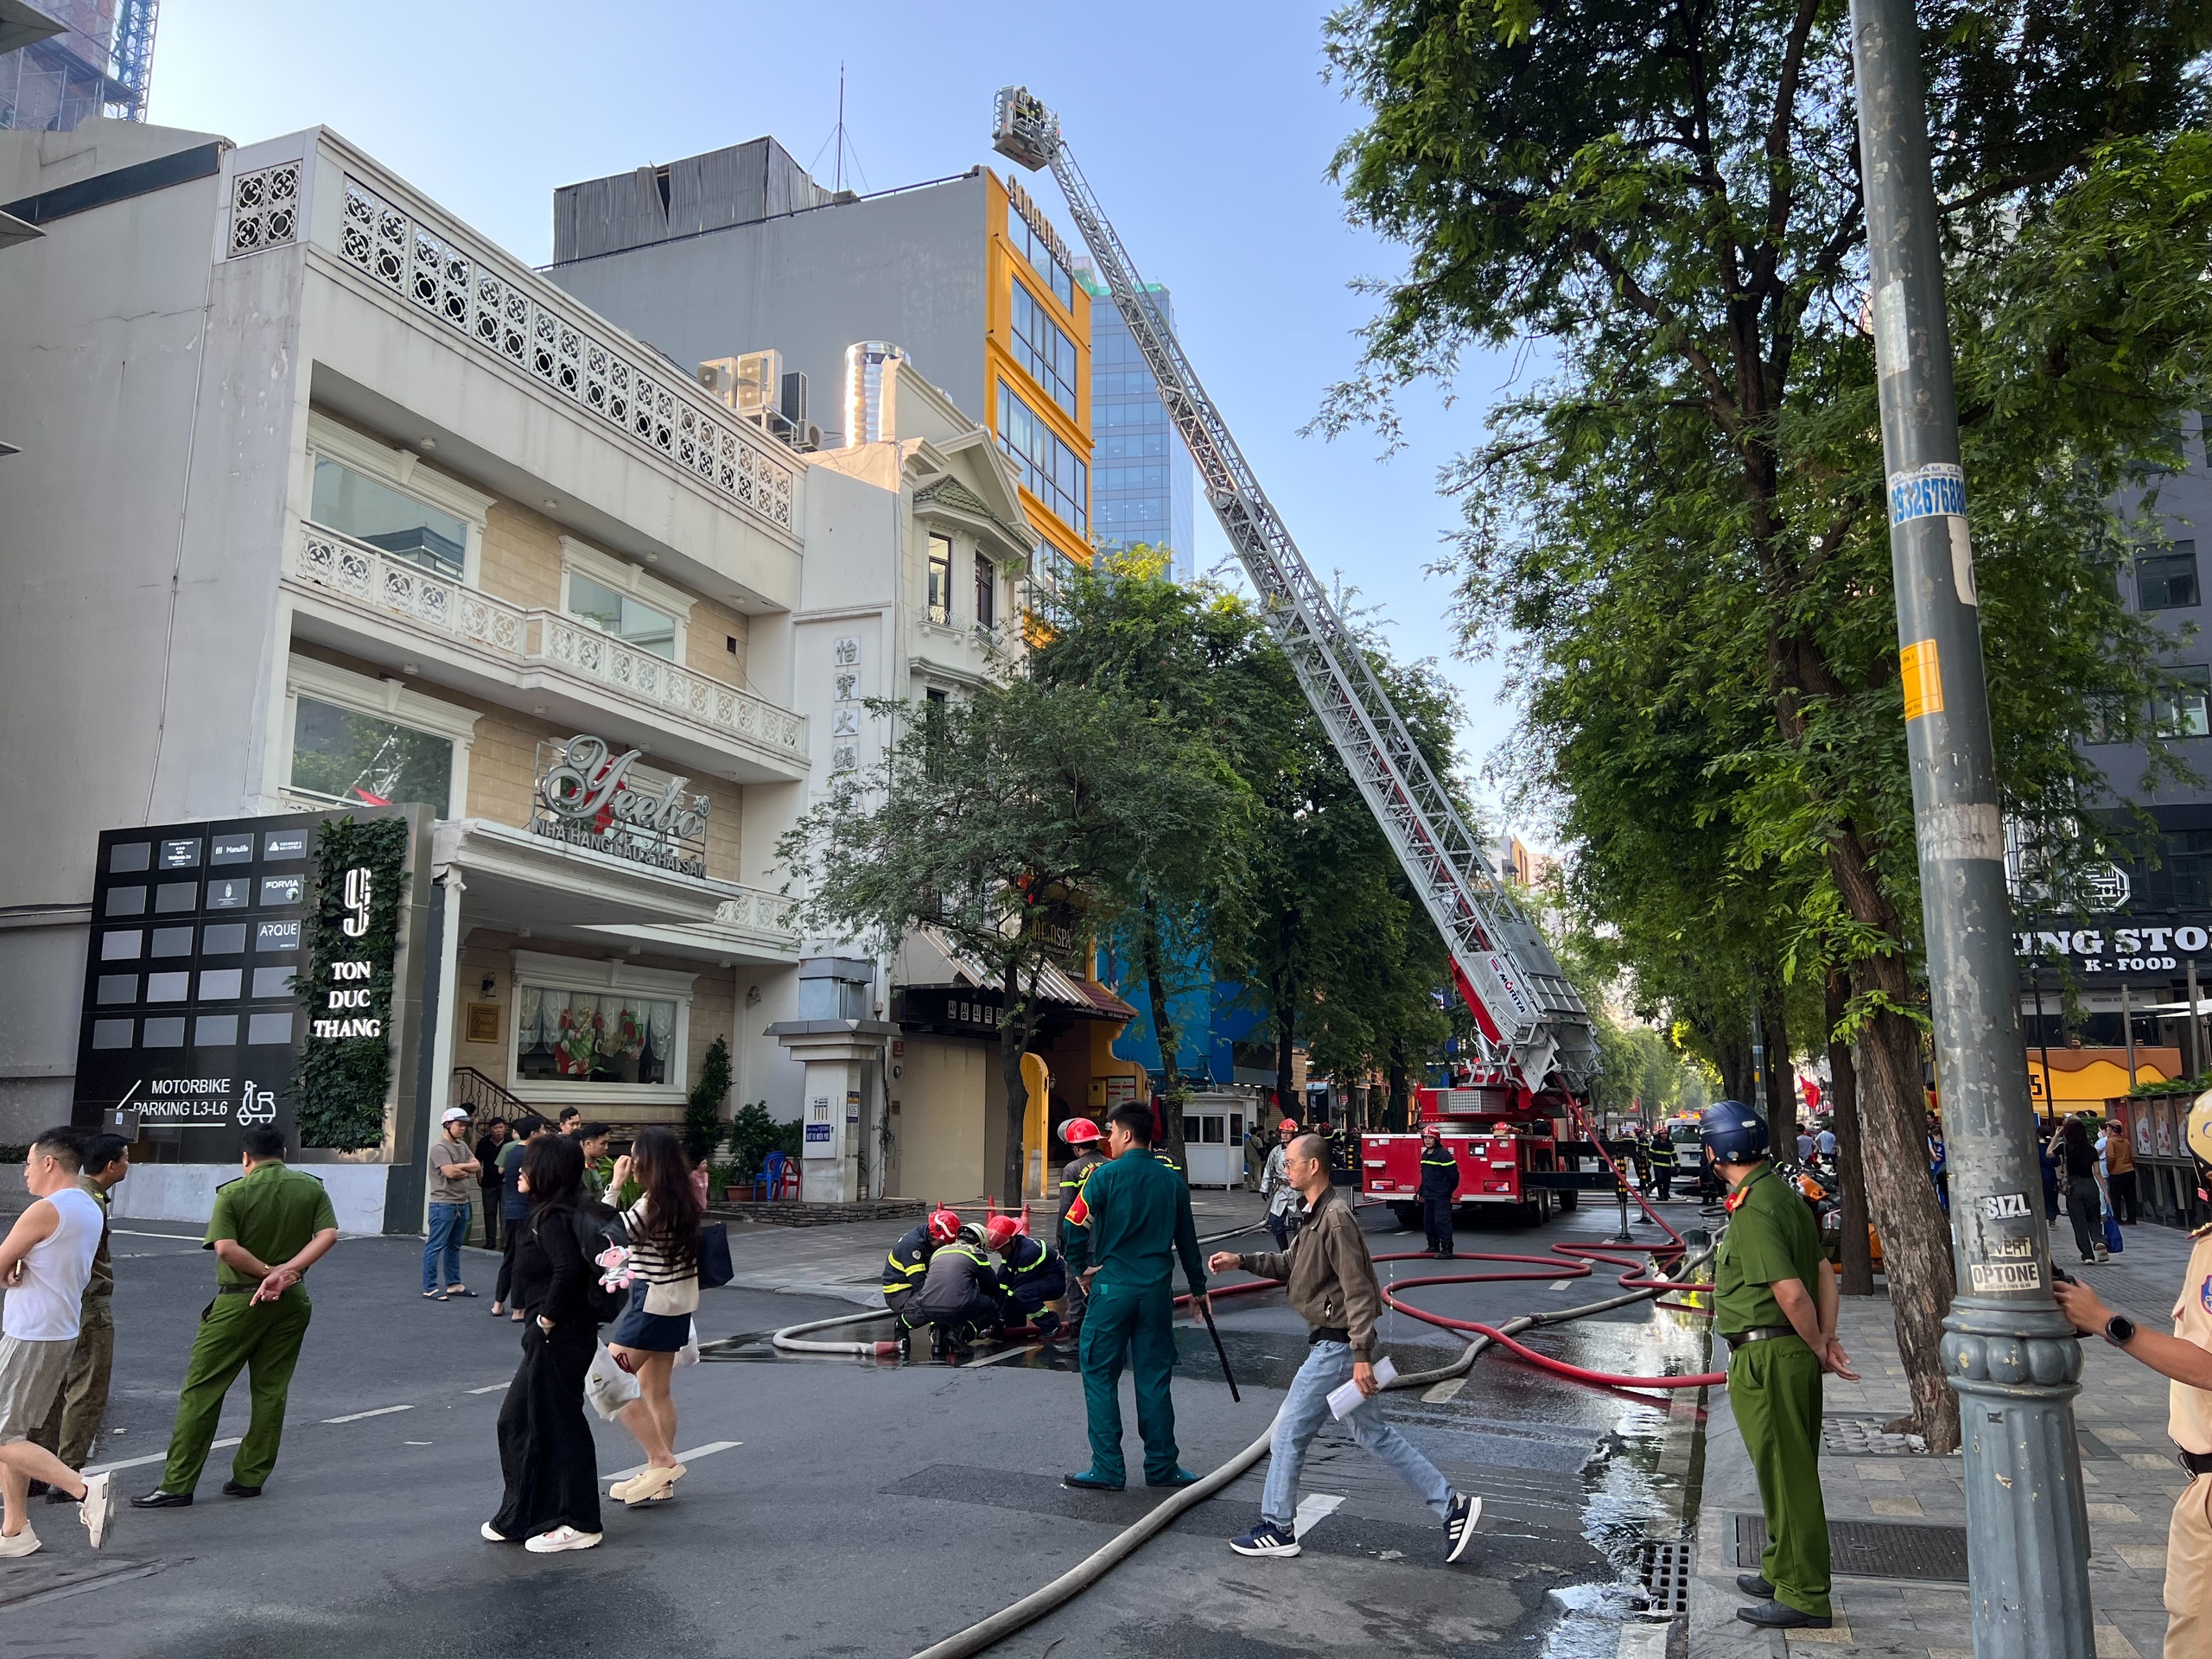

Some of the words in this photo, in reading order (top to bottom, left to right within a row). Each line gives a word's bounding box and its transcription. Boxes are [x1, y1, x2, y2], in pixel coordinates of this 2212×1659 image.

[543, 734, 704, 839] Yeebo
[645, 849, 654, 864] &
[265, 880, 299, 889] FORVIA
[259, 923, 298, 937] ARQUE
[2012, 930, 2105, 956] ING
[2114, 926, 2212, 953] STO
[332, 961, 371, 981] TON
[328, 989, 371, 1009] DUC
[1499, 974, 1526, 1014] MORITA
[314, 1019, 380, 1038] THANG
[151, 1078, 231, 1094] MOTORBIKE
[133, 1102, 190, 1116] PARKING
[193, 1101, 228, 1116] L3-L6
[1973, 1264, 2037, 1284] OPTONE
